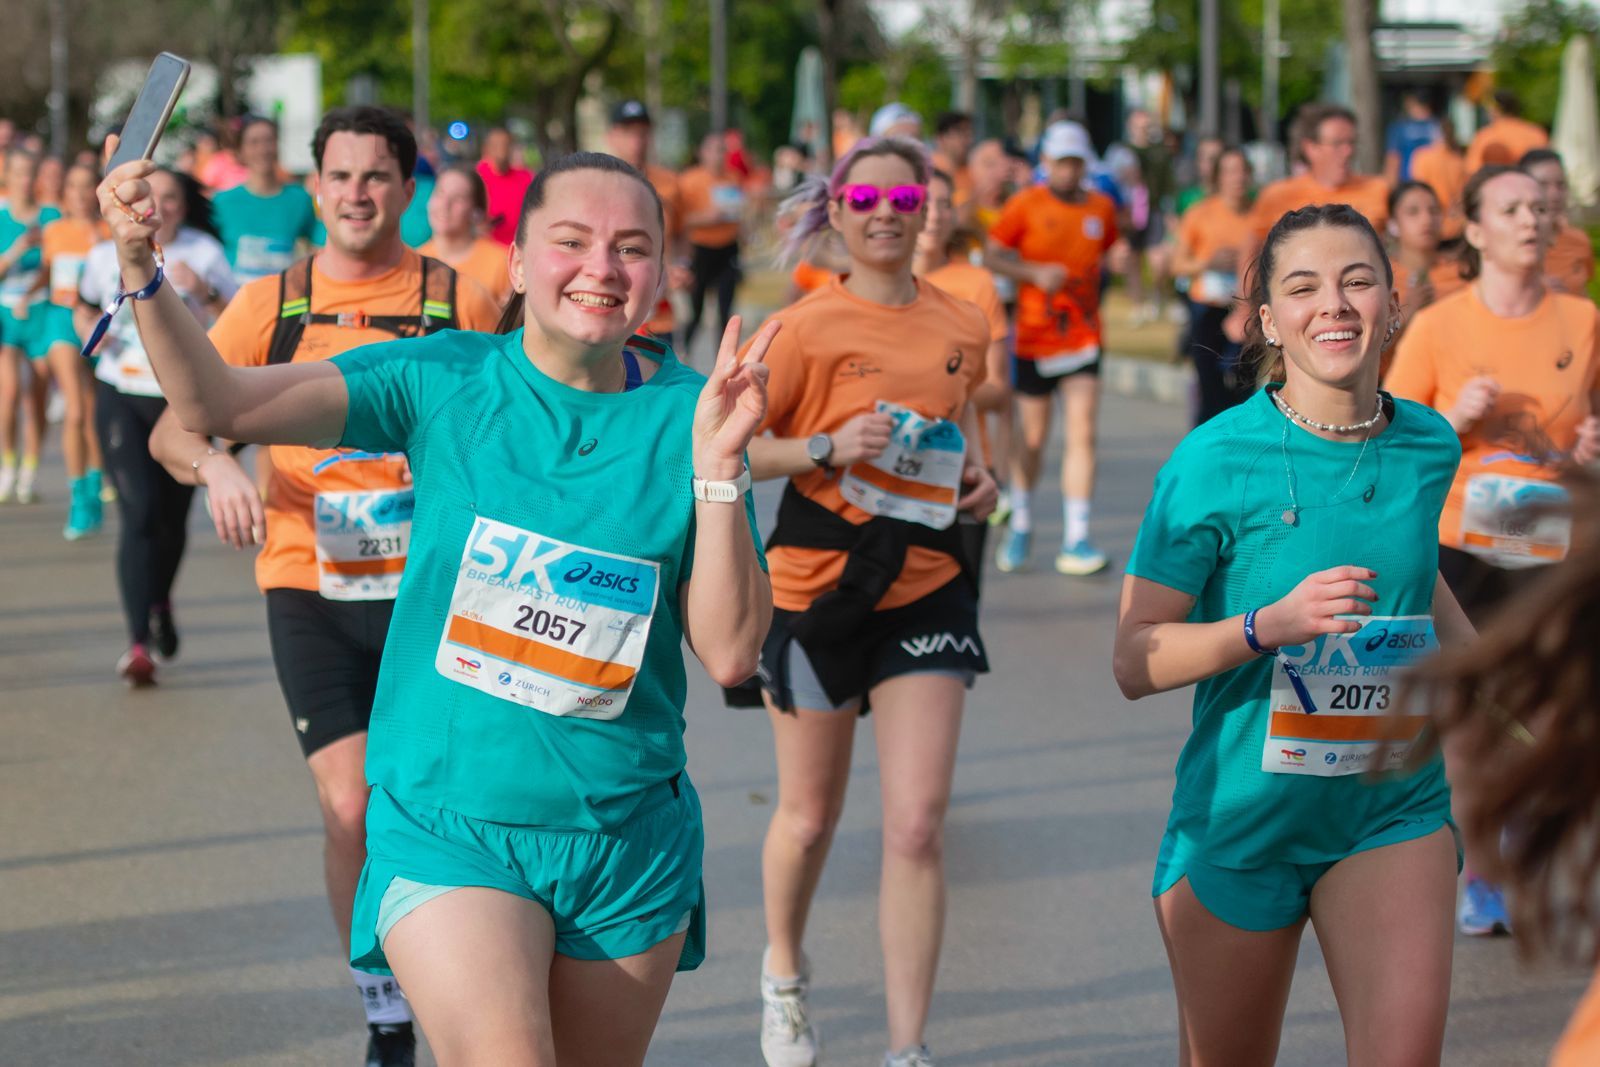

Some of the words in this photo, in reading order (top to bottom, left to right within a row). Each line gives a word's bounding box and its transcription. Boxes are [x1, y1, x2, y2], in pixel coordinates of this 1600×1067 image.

[358, 538, 401, 556] 2231
[467, 522, 564, 590] 5K
[466, 568, 556, 602] BREAKFAST
[555, 595, 589, 613] RUN
[513, 604, 587, 646] 2057
[1362, 665, 1389, 677] RUN
[515, 680, 551, 697] ZURICH
[1330, 684, 1391, 710] 2073
